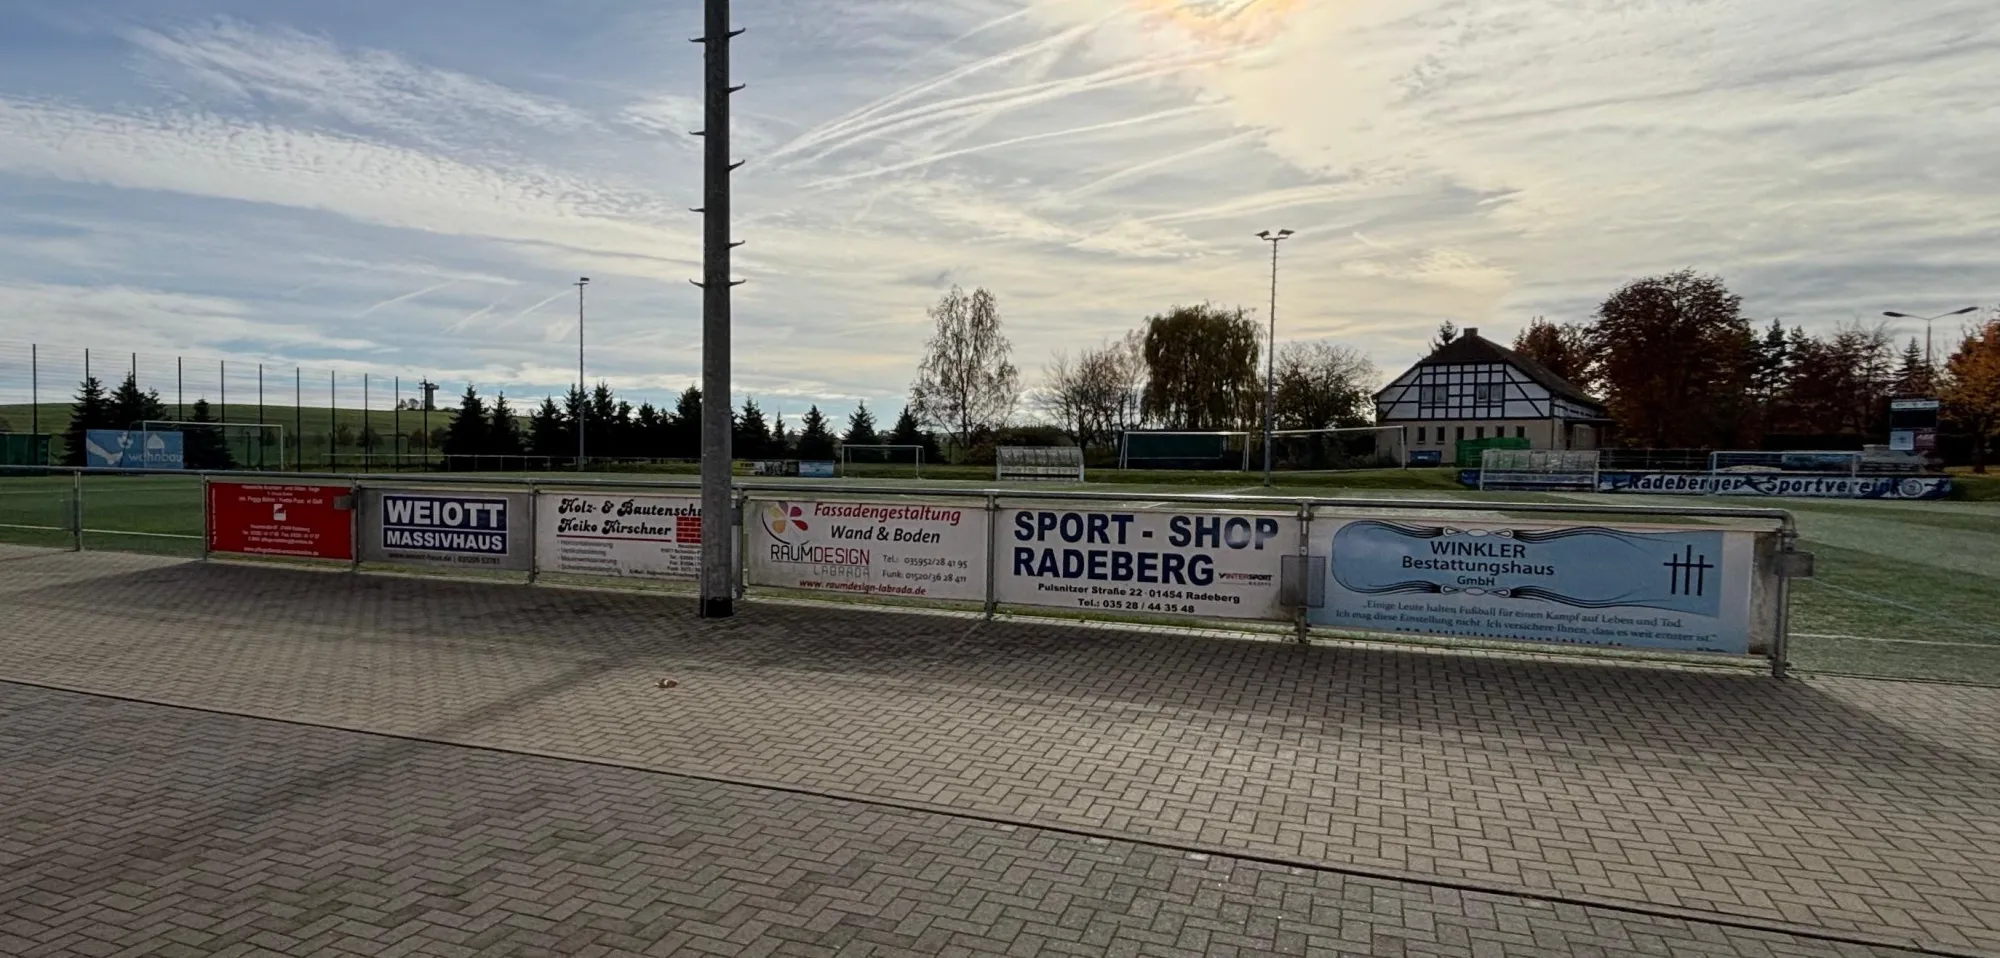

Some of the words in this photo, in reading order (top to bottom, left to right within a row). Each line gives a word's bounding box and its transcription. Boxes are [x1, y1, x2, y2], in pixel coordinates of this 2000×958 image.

[128, 452, 183, 463] wohnbau
[386, 499, 504, 528] WEIOTT
[558, 497, 597, 514] Holz-
[601, 500, 614, 514] &
[814, 502, 961, 526] Fassadengestaltung
[557, 517, 598, 533] Heiko
[601, 519, 671, 536] Kirschner
[831, 525, 874, 541] Wand
[876, 527, 888, 541] &
[893, 528, 941, 544] Boden
[1014, 510, 1134, 545] SPORT
[1142, 530, 1153, 538] -
[1168, 515, 1279, 550] SHOP
[387, 530, 503, 551] MASSIVHAUS
[1430, 541, 1526, 559] WINKLER
[771, 544, 870, 565] RAUMDESIGN
[904, 556, 946, 568] 035952/28
[957, 558, 968, 569] 95
[813, 566, 870, 578] LABRADA
[1013, 547, 1214, 586] RADEBERG
[1402, 555, 1555, 576] Bestattungshaus
[882, 570, 903, 579] Funk:
[905, 571, 942, 582] 01520/36
[943, 572, 954, 582] 28
[1457, 575, 1496, 586] GmbH
[825, 580, 926, 596] raumdesign-labrada.de
[1038, 583, 1089, 594] Pulsnitzer
[1091, 586, 1127, 597] Straße
[1129, 587, 1143, 597] 22
[1149, 589, 1183, 600] 01454
[1185, 591, 1241, 605] Radeberg
[1078, 598, 1100, 608] Tel.:
[1103, 600, 1123, 609] 035
[1125, 600, 1138, 610] 28
[1147, 602, 1162, 611] 44
[1164, 602, 1178, 612] 35
[1181, 603, 1195, 613] 48
[1398, 602, 1424, 612] Leute
[1426, 603, 1456, 614] halten
[1459, 605, 1496, 617] Fußball
[1499, 607, 1513, 618] für
[1515, 611, 1543, 620] einen
[1546, 611, 1579, 624] Kampf
[1581, 613, 1600, 623] auf
[1602, 614, 1633, 625] Leben
[1636, 616, 1657, 627] und
[1336, 609, 1350, 618] Ich
[1352, 612, 1371, 621] mag
[1373, 611, 1397, 621] diese
[1400, 614, 1453, 627] Einstellung
[1486, 619, 1502, 628] Ich
[1504, 622, 1554, 632] versichere
[1592, 626, 1615, 636] dass
[1655, 631, 1693, 641] ernster
